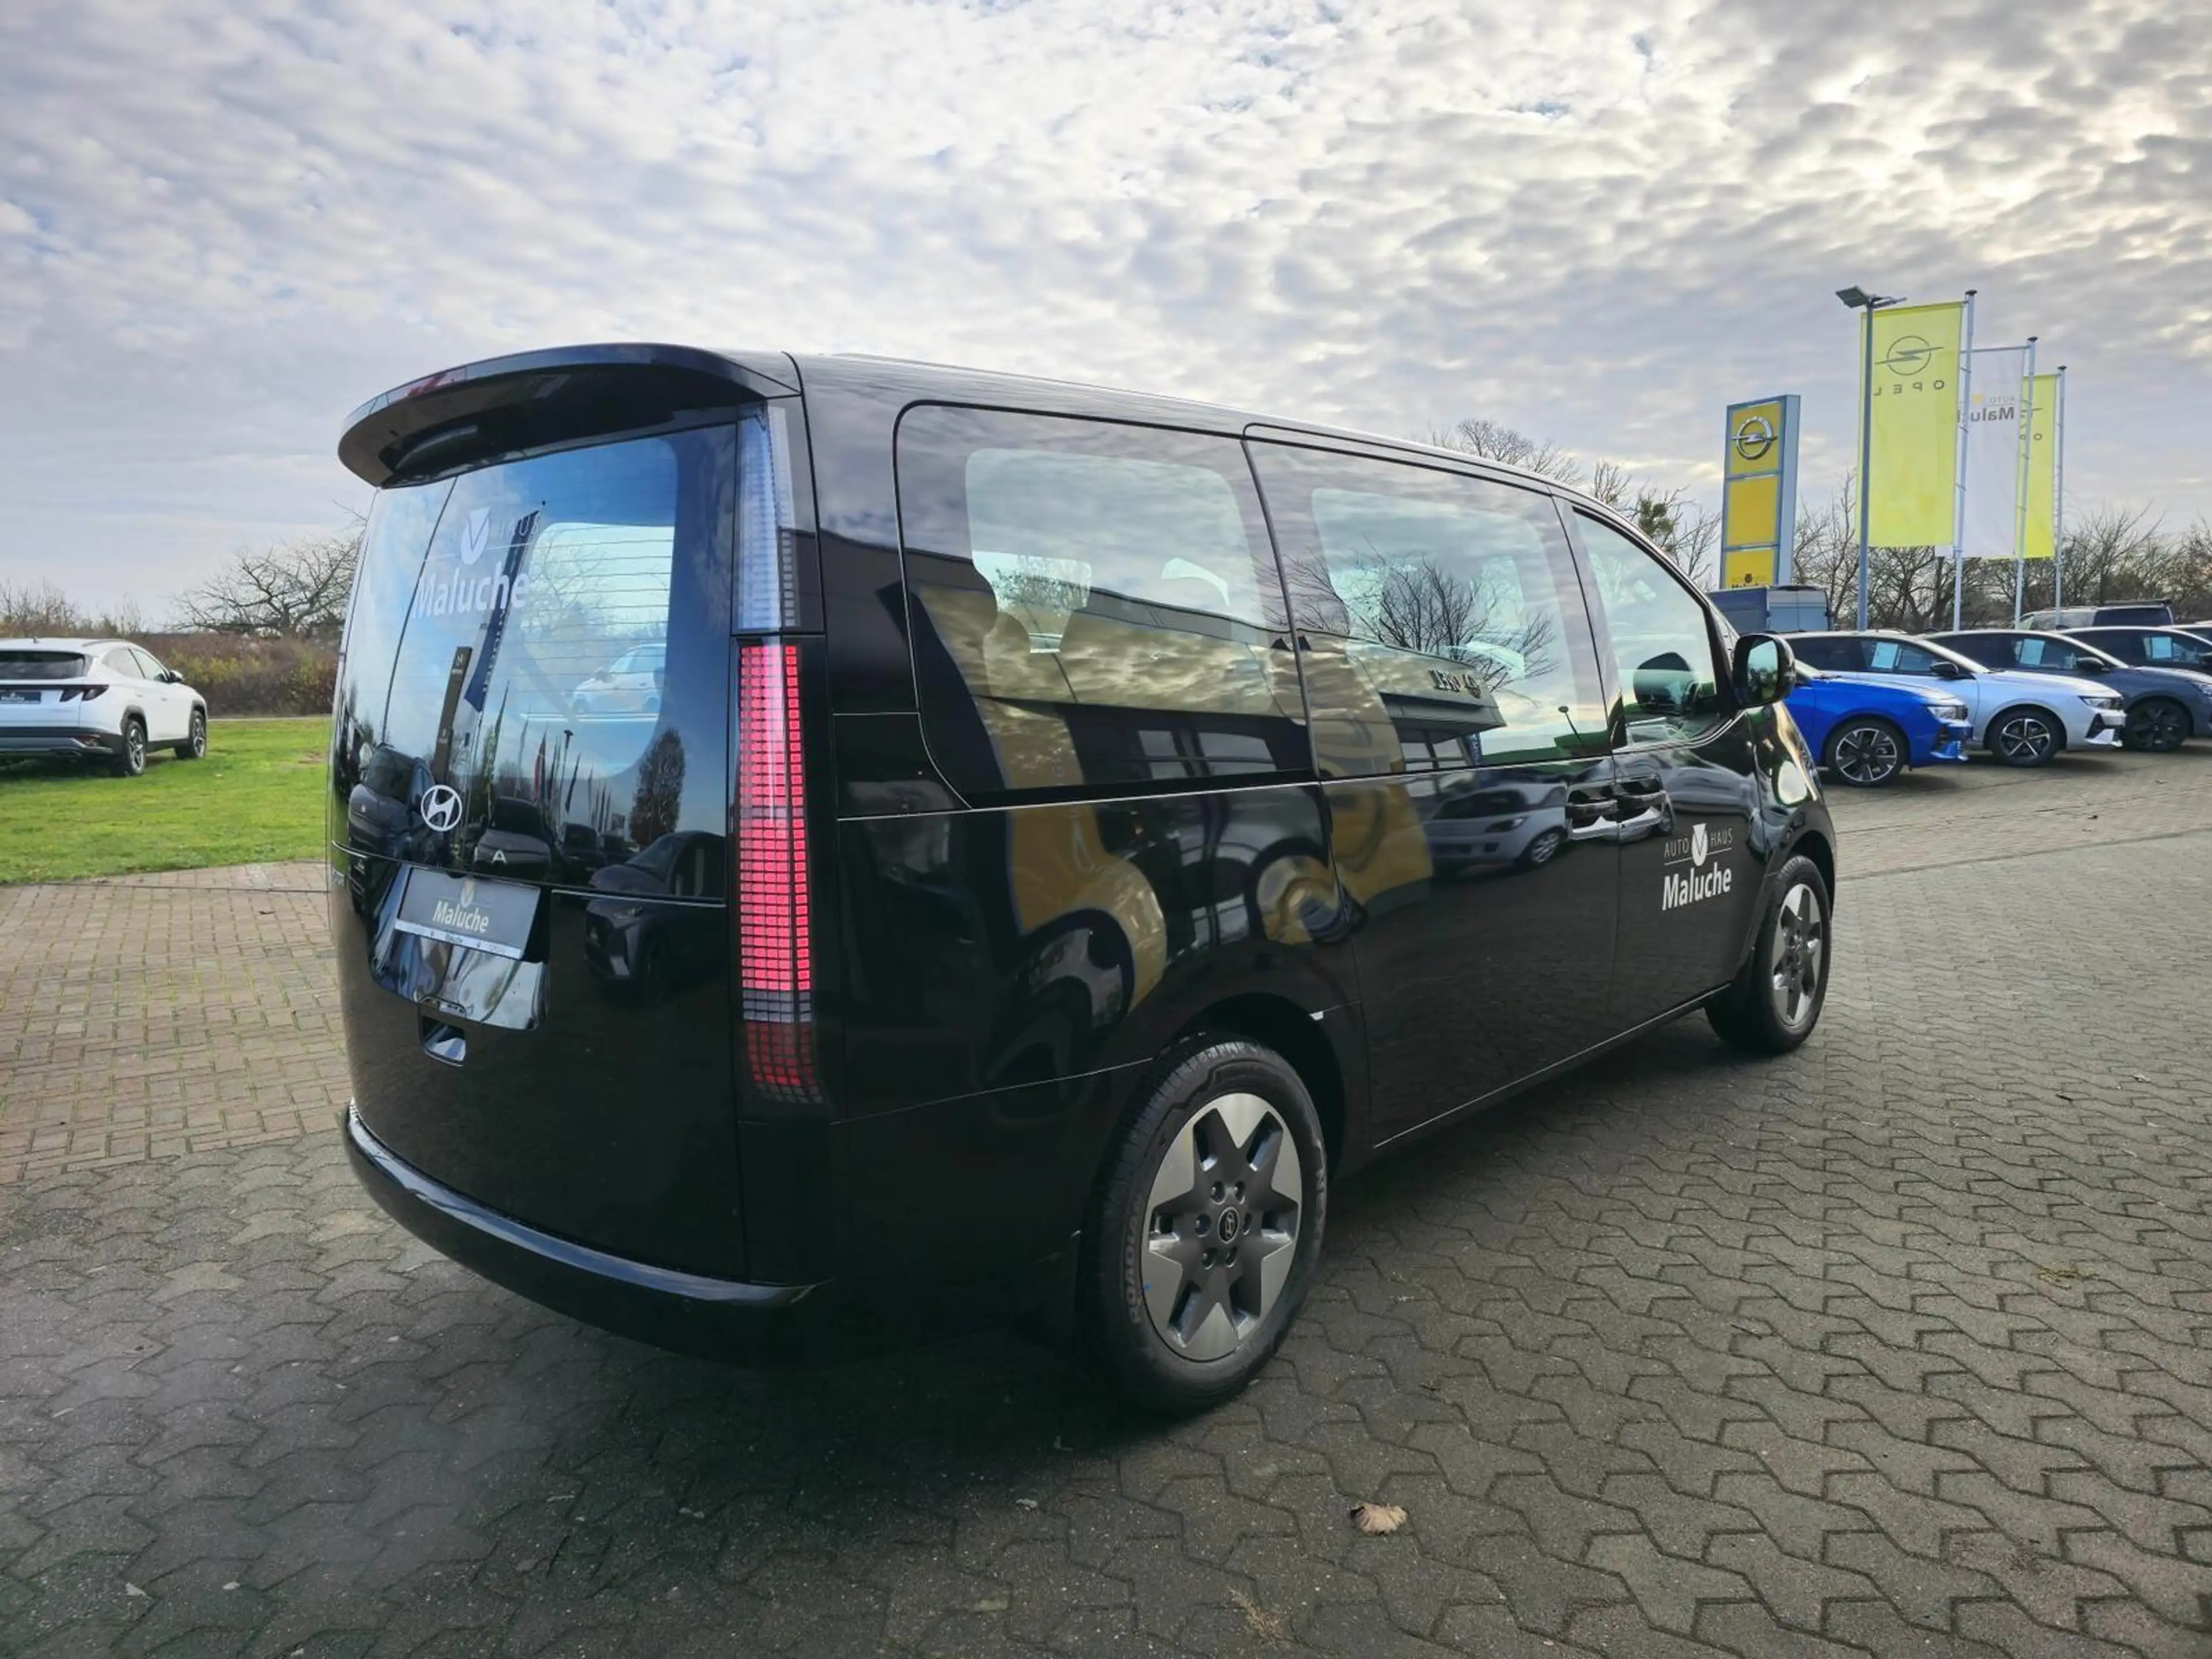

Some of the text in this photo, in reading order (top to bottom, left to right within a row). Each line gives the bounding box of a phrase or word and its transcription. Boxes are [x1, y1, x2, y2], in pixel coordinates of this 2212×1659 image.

[411, 561, 530, 618] Maluche
[1664, 828, 1733, 858] AUTO HAUS
[1662, 862, 1732, 910] Maluche
[433, 900, 489, 933] Maluche
